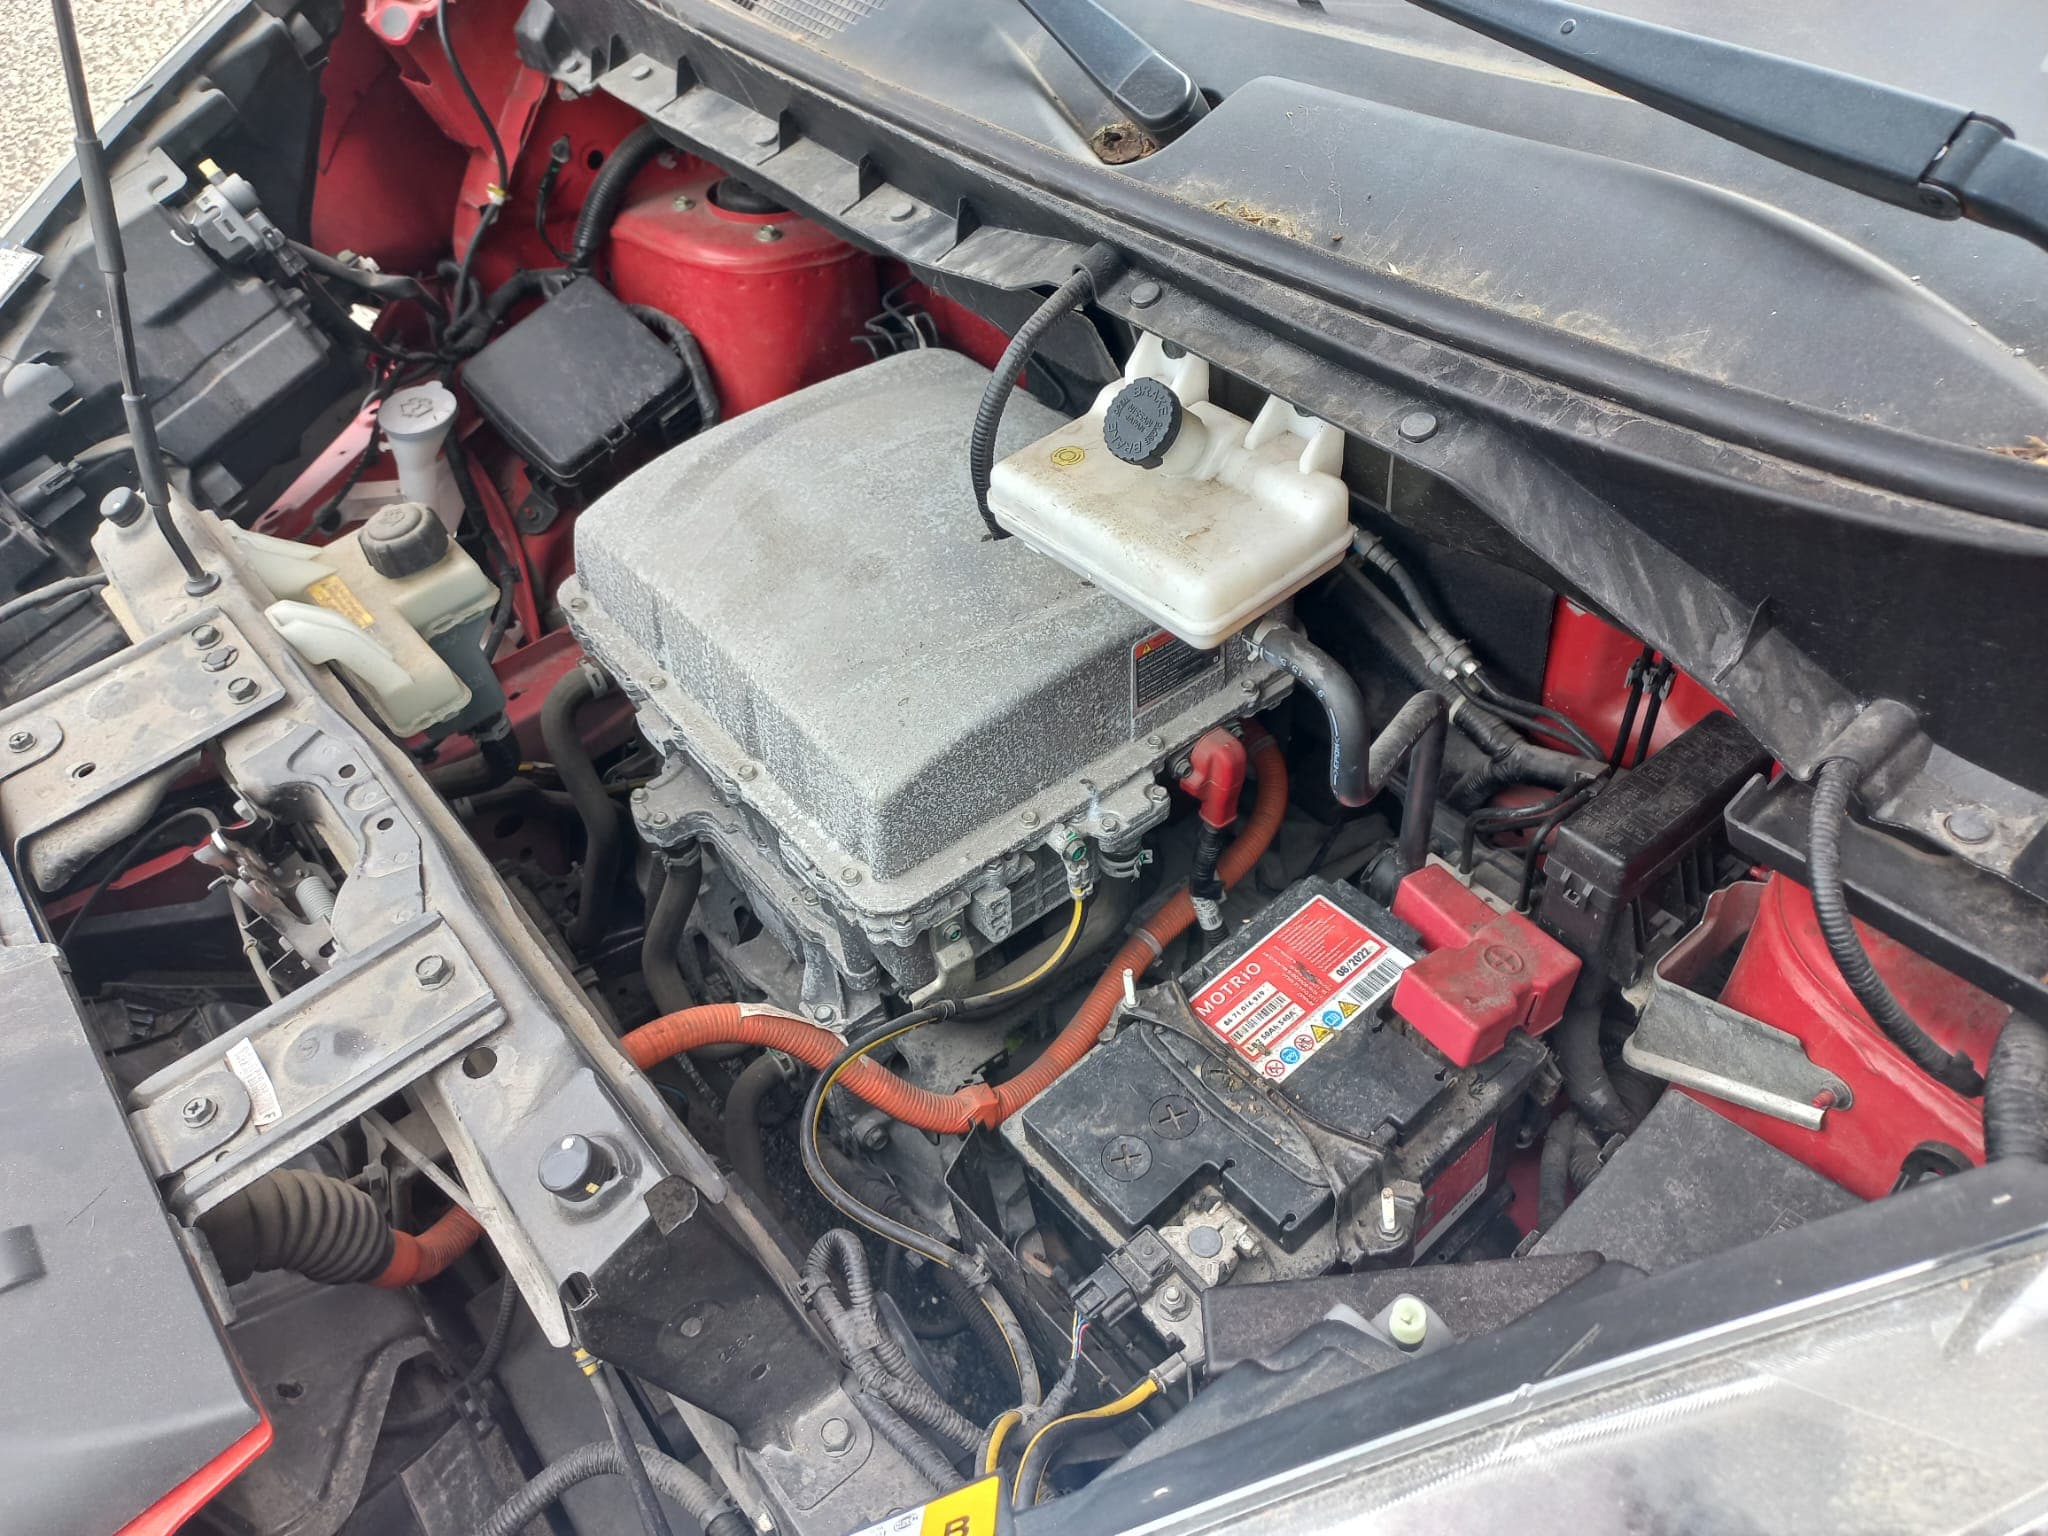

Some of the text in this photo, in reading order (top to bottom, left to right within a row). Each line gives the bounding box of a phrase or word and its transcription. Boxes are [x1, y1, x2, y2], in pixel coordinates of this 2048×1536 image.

[1133, 385, 1168, 417] BRAKE
[1108, 421, 1142, 455] BRAKE
[1125, 414, 1146, 433] JAPAN
[1335, 946, 1371, 978] 08/2022
[1260, 1025, 1280, 1041] 50Ah
